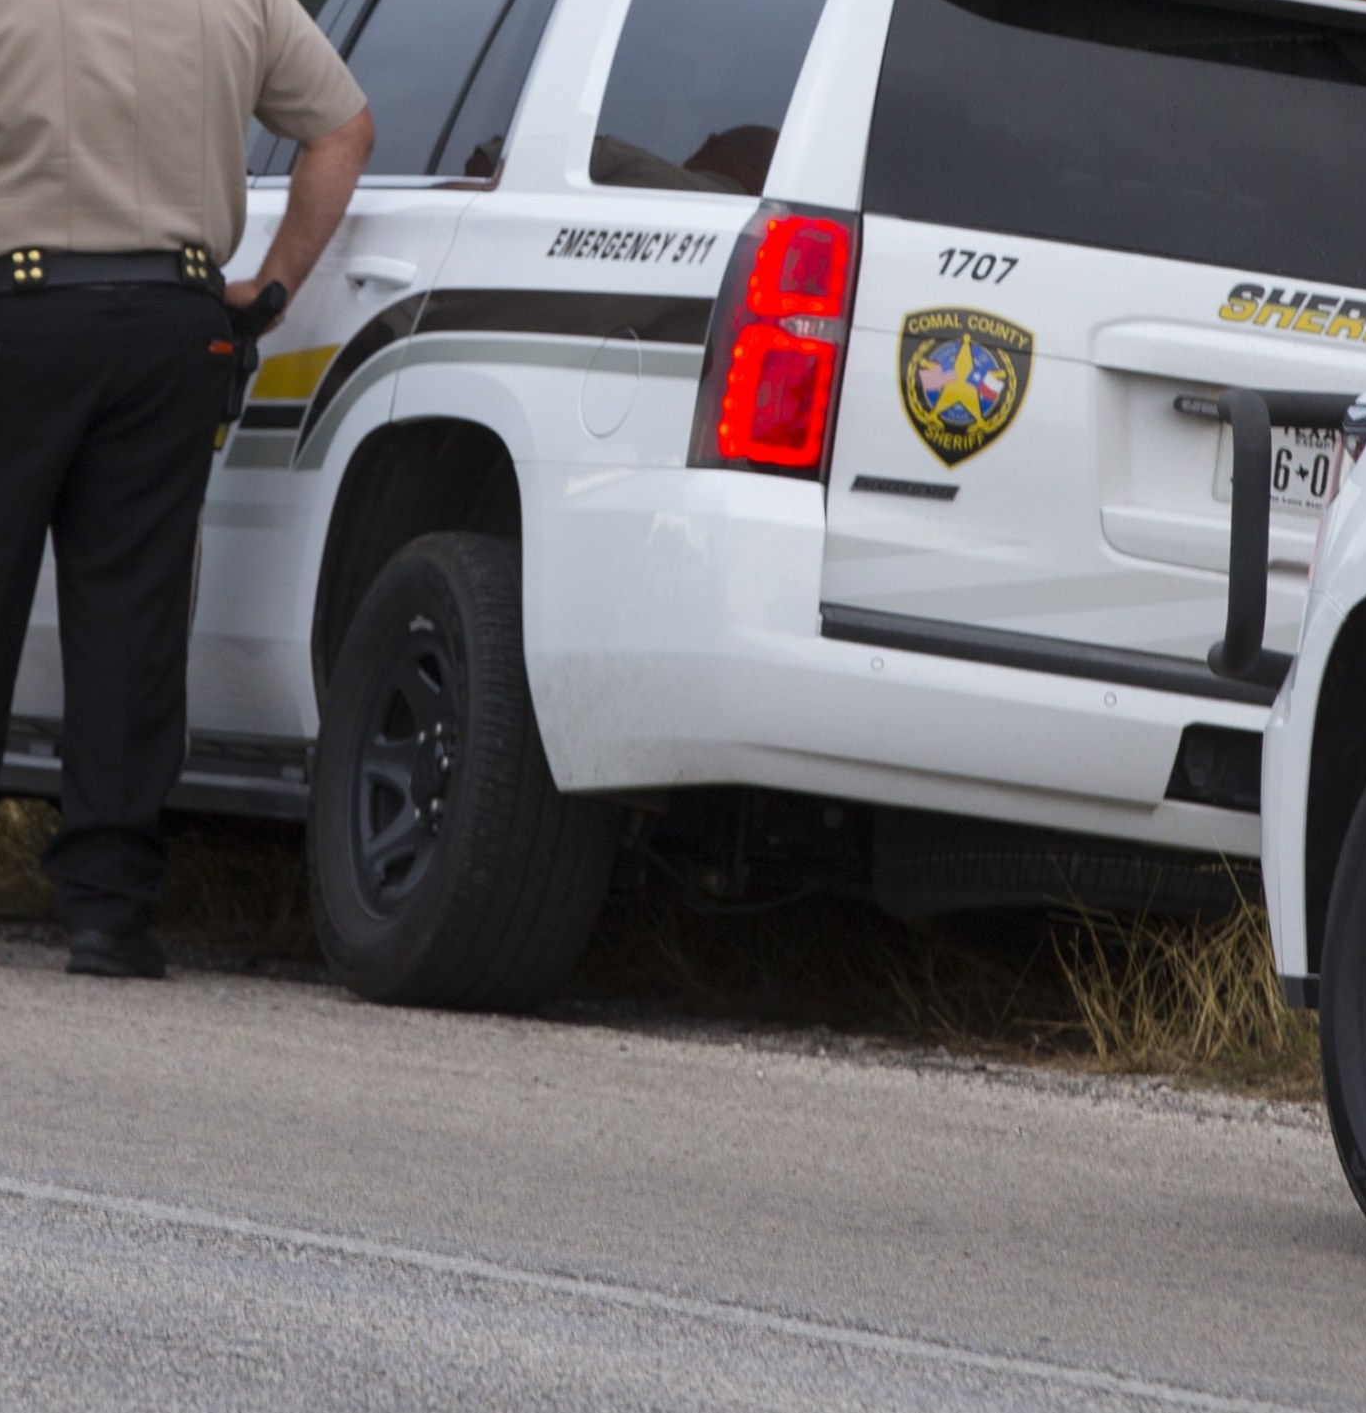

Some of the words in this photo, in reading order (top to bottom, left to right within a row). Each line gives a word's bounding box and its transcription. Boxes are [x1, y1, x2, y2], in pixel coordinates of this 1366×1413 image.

[546, 227, 677, 263] EMERGENCY
[672, 232, 718, 265] 911
[938, 247, 1019, 285] 1707
[908, 313, 963, 335] COMAL
[967, 315, 1029, 350] COUNTY
[924, 423, 987, 452] SHERIFF
